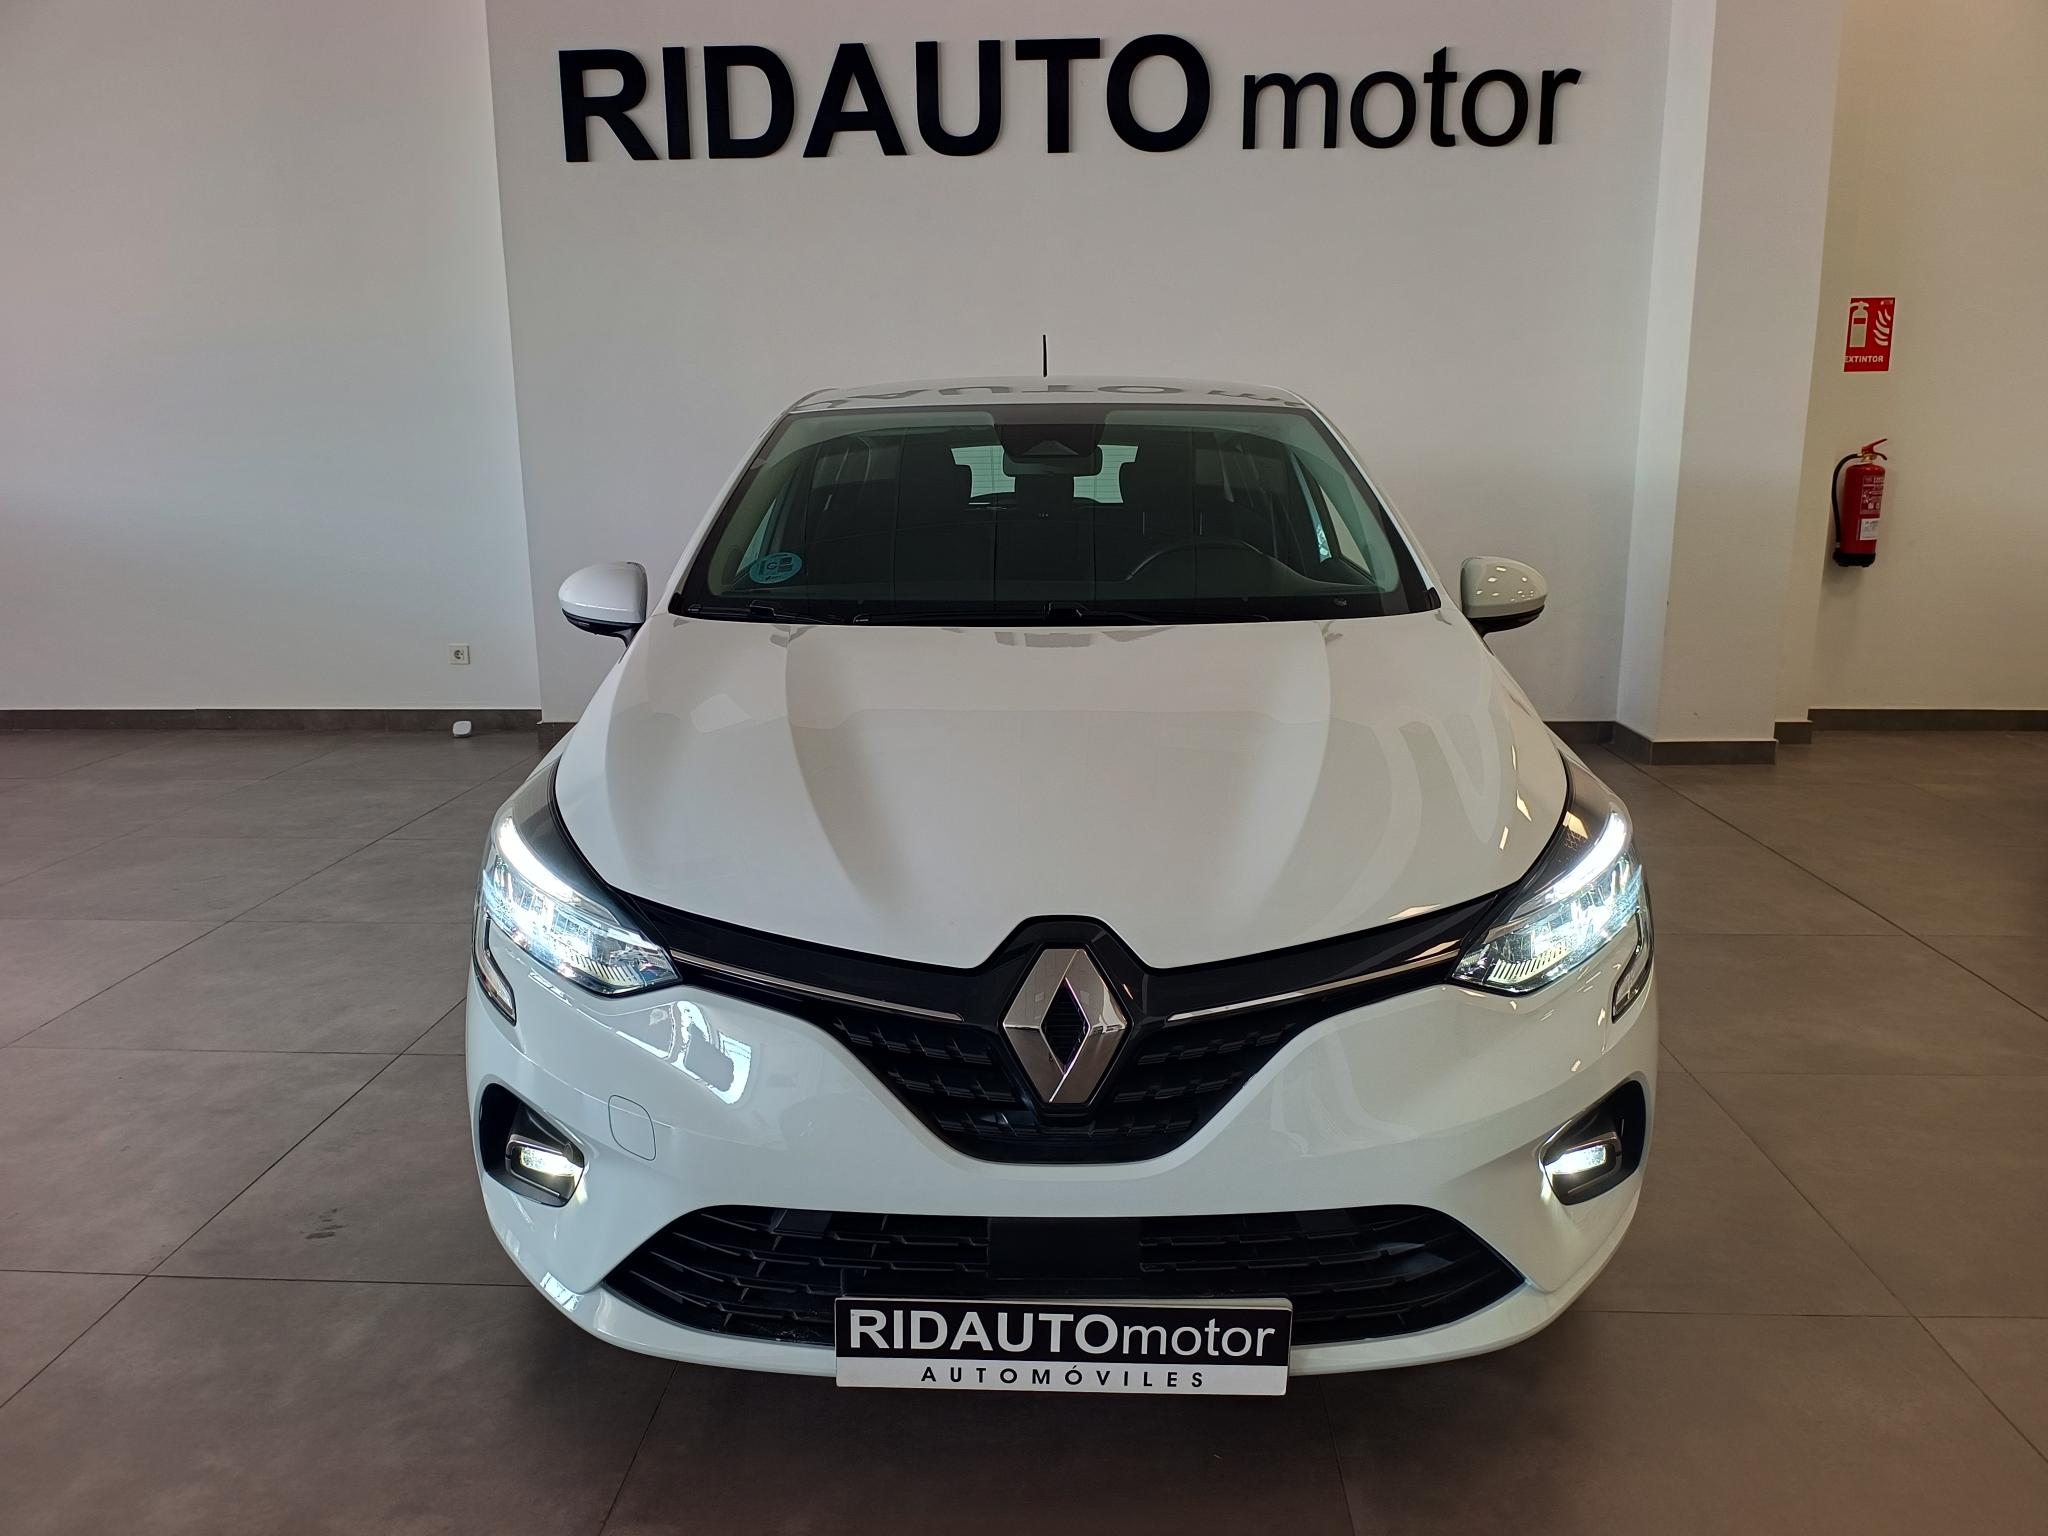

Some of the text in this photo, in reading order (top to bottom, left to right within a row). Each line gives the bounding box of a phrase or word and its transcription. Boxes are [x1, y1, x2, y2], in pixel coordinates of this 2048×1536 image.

[559, 34, 1581, 162] RIDAUTO motor
[849, 1309, 1275, 1357] RIDAUTOmotor
[921, 1365, 1203, 1388] AUTOMÓVILES
